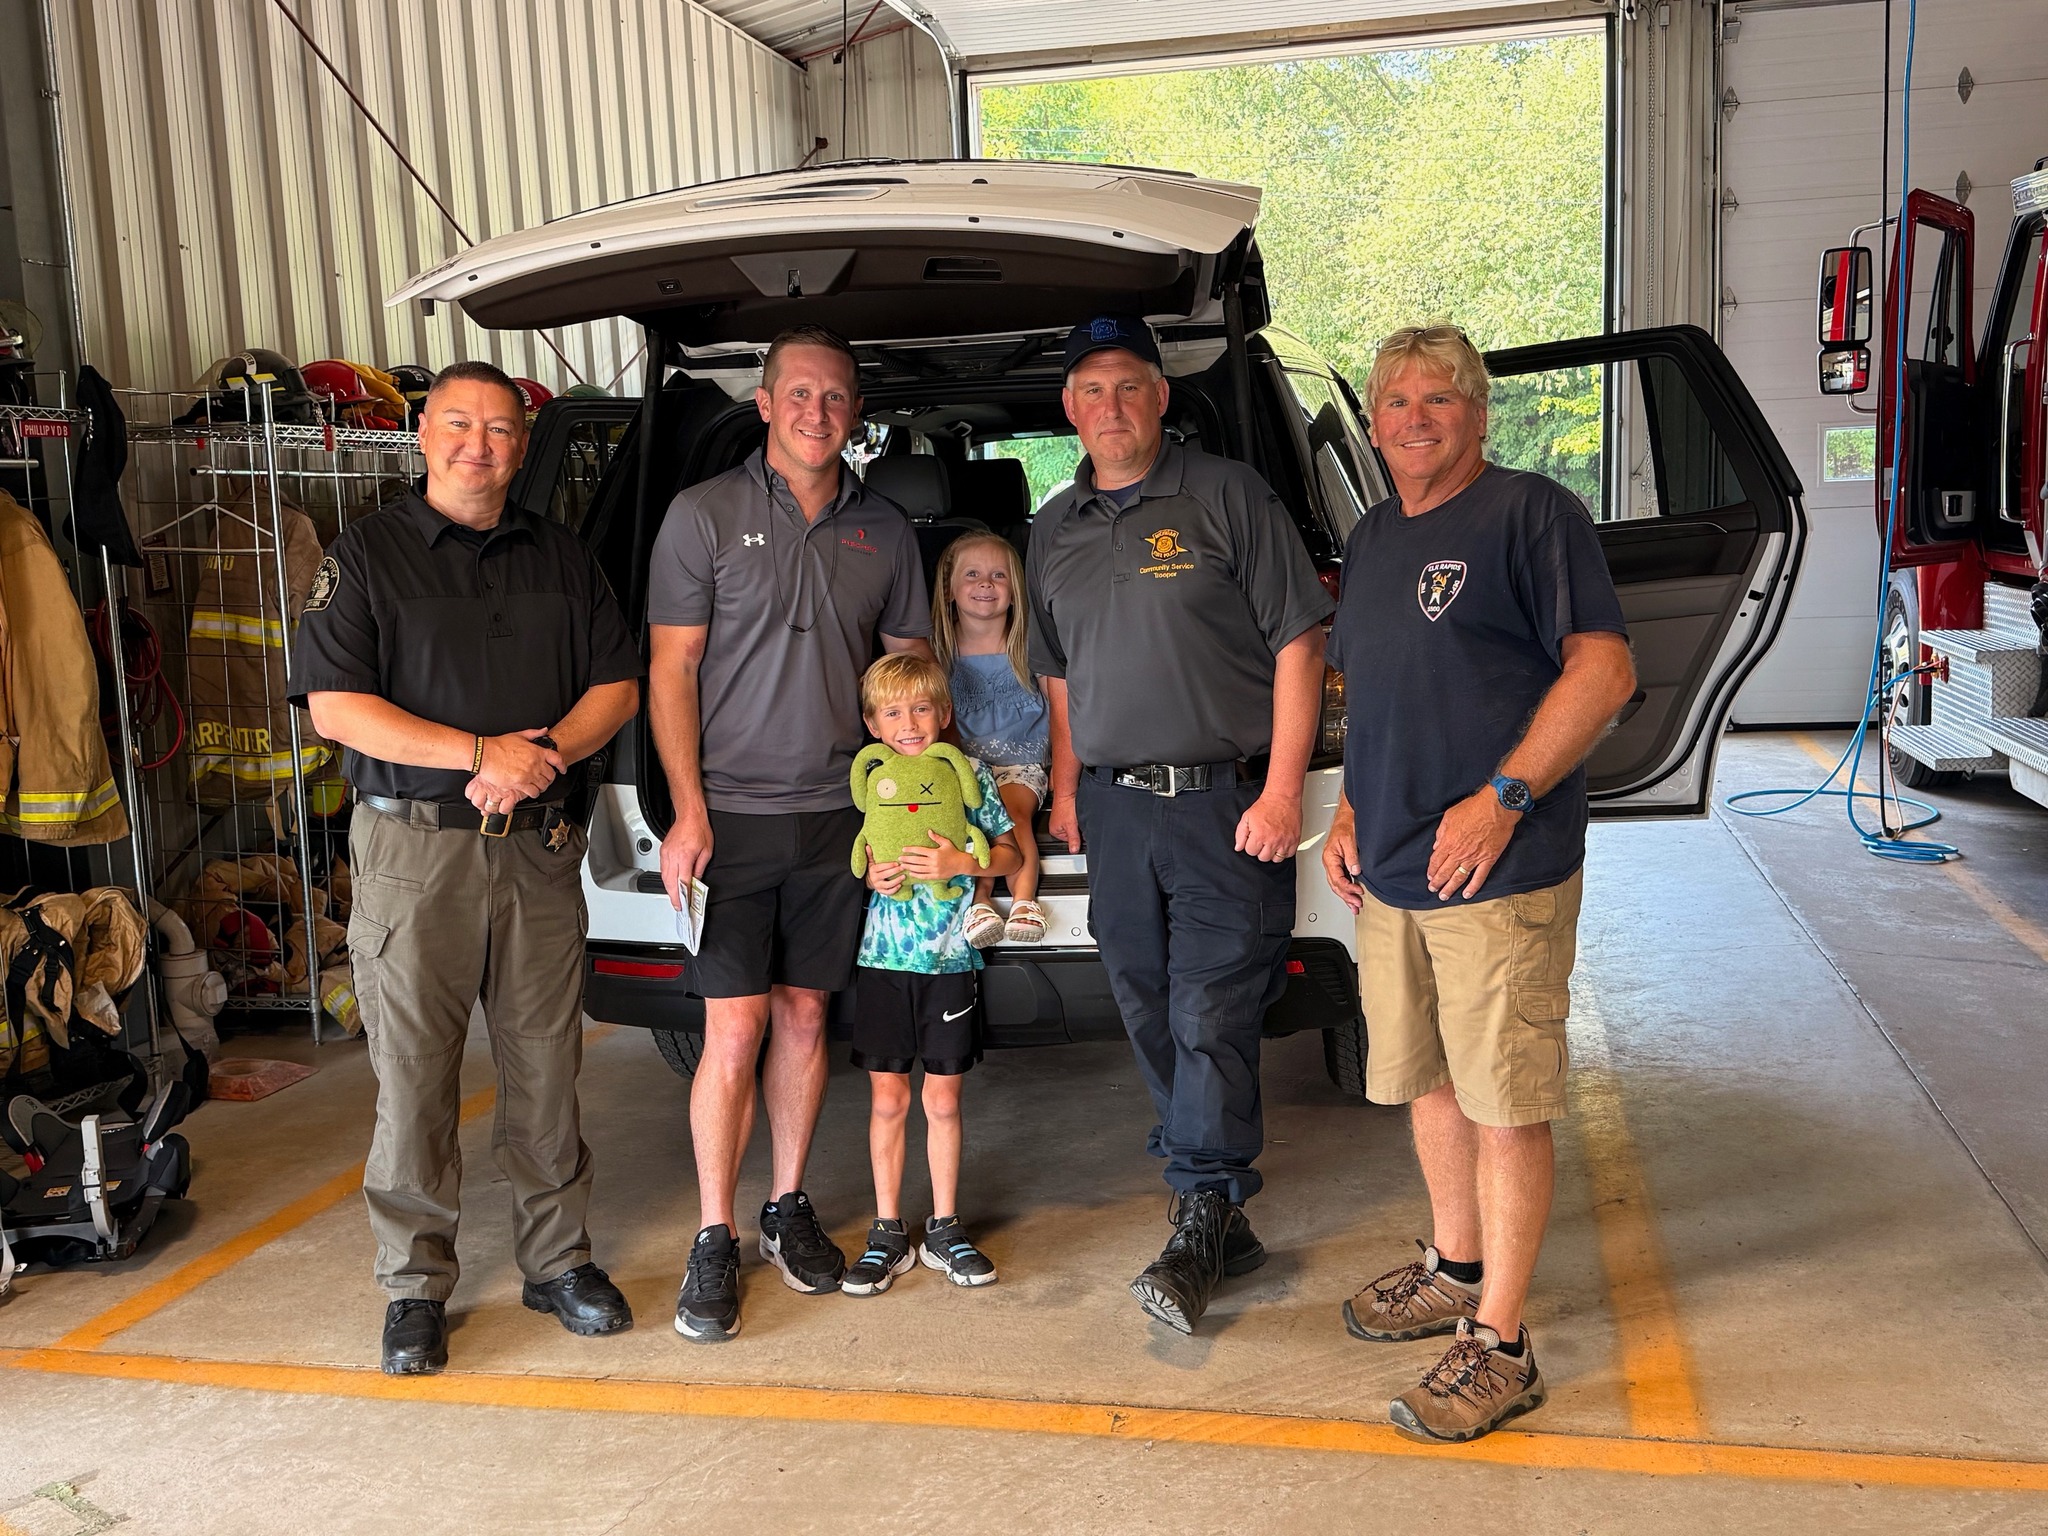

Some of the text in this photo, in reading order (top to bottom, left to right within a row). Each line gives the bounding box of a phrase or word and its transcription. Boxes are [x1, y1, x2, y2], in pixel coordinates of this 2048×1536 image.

[24, 424, 69, 436] PHILLIP V D B
[1139, 562, 1195, 574] Community Service
[1427, 563, 1462, 572] ELK RAPIDS
[1153, 571, 1177, 579] Trooper
[189, 721, 270, 753] ARPENTER
